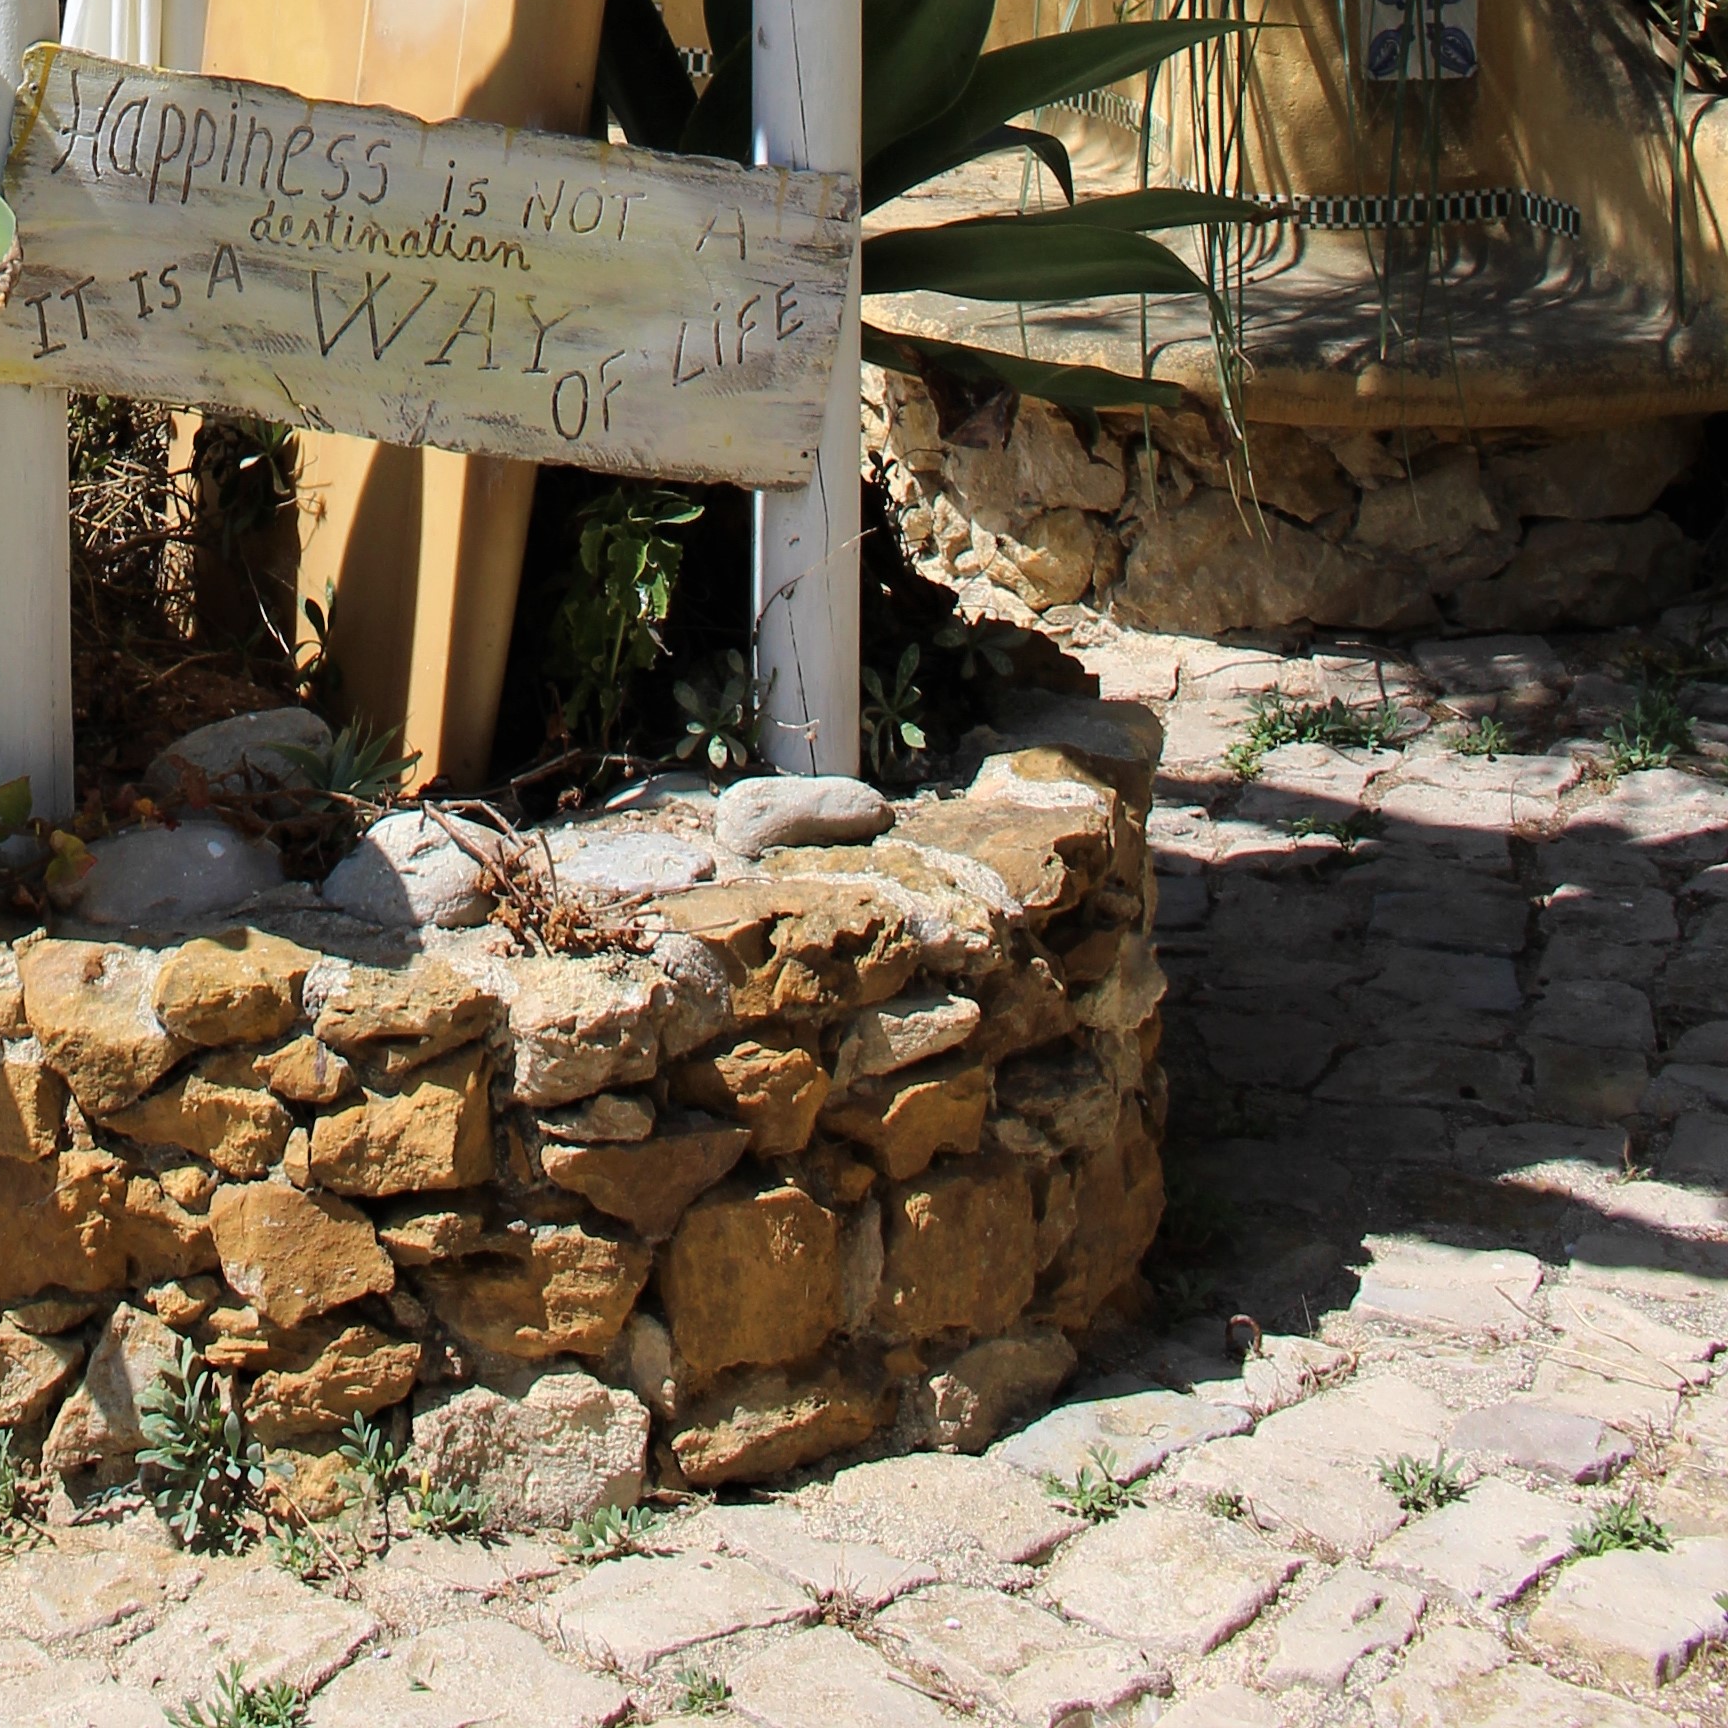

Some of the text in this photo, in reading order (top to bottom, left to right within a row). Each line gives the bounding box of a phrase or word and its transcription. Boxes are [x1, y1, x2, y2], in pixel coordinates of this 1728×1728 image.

[50, 69, 392, 205] Happiness
[522, 179, 646, 242] NOT
[694, 206, 749, 260] A
[24, 274, 96, 360] IT
[130, 263, 182, 320] IS
[207, 242, 244, 298] A
[310, 269, 590, 374] WAY
[550, 349, 627, 441] OF
